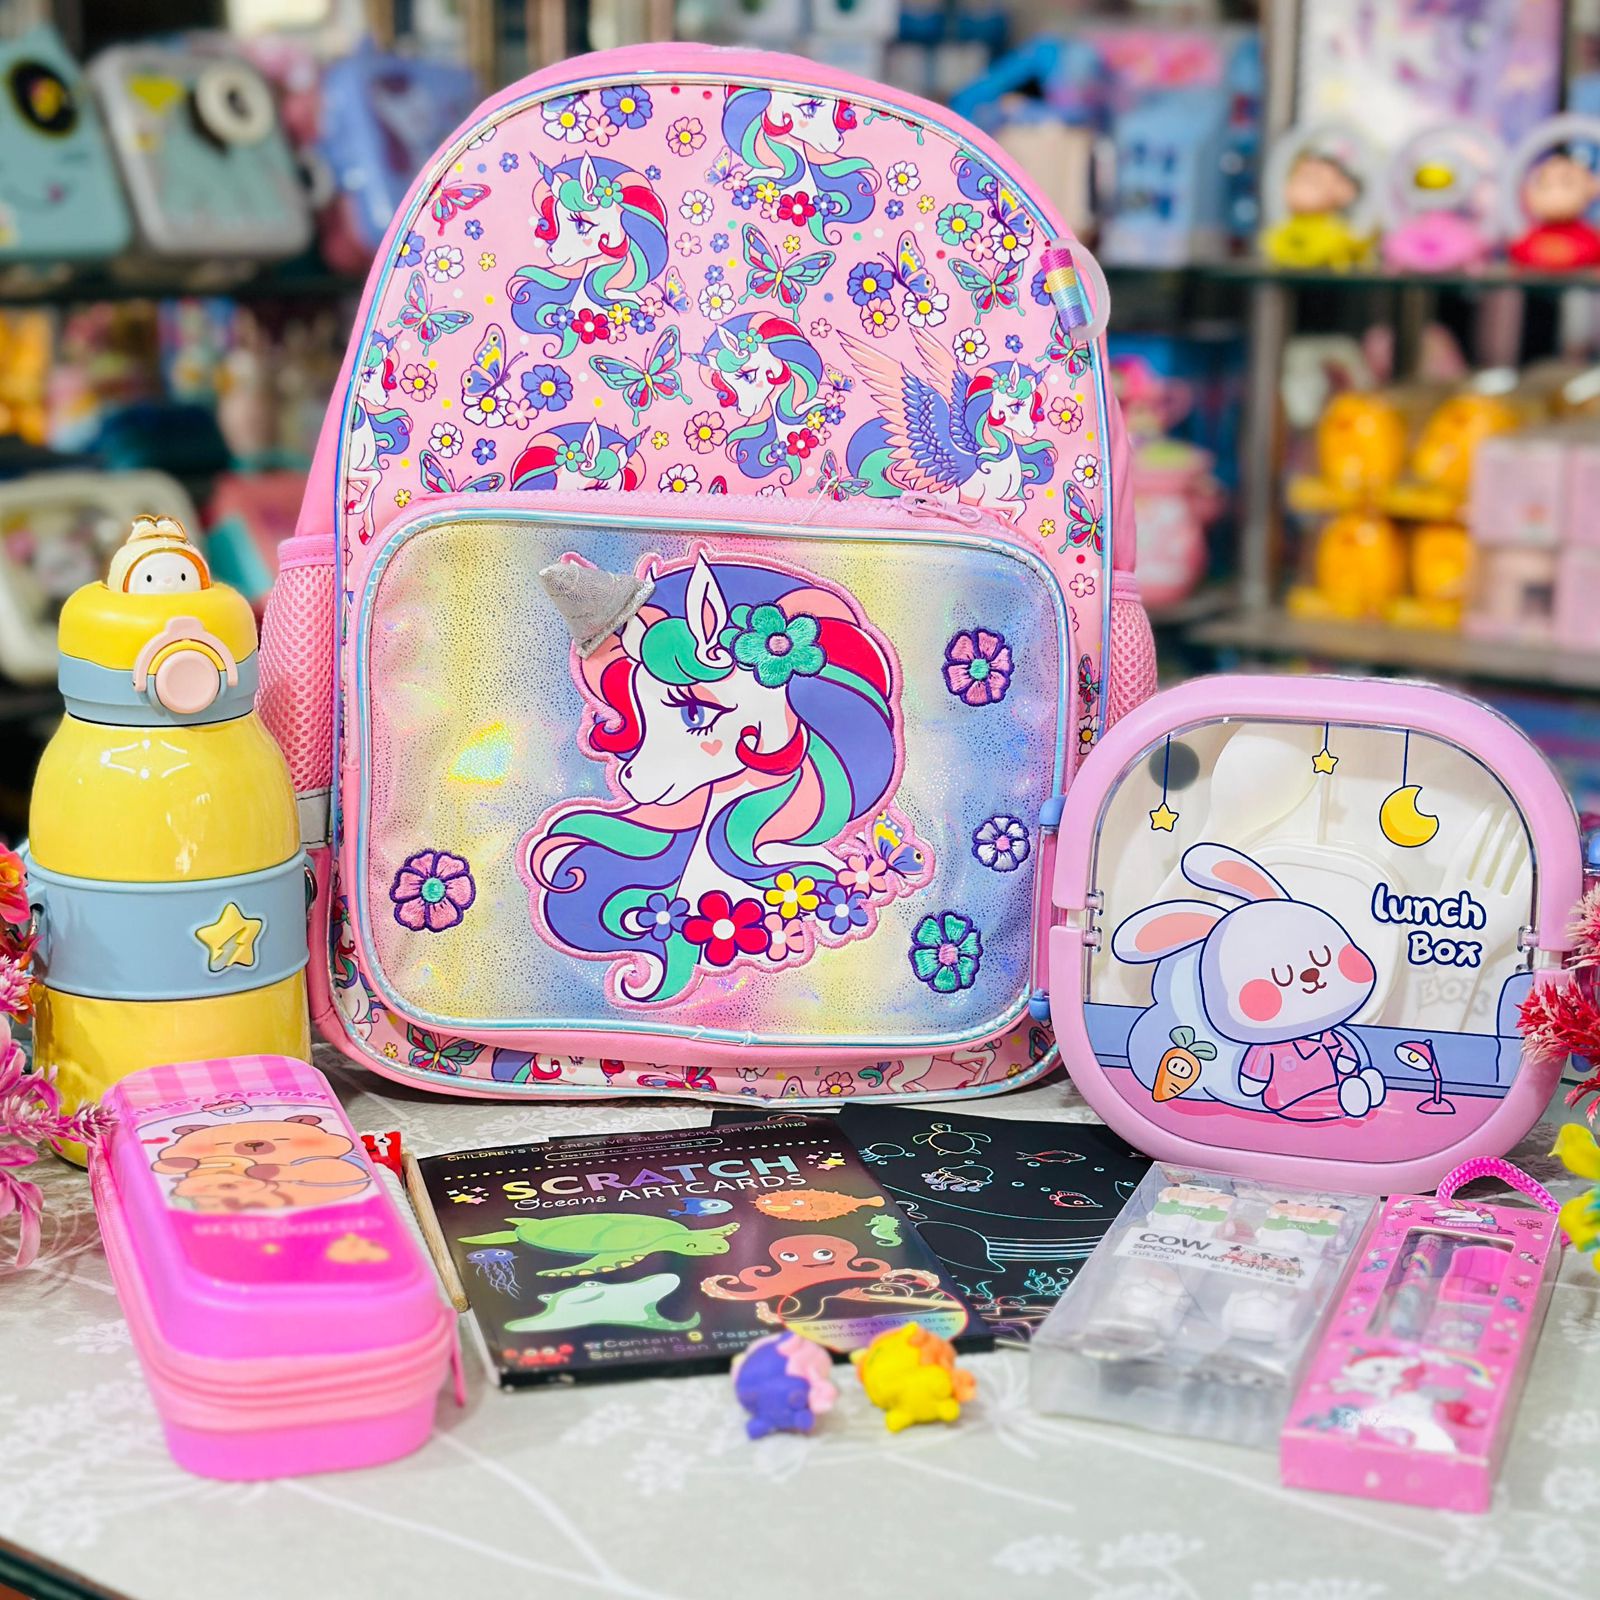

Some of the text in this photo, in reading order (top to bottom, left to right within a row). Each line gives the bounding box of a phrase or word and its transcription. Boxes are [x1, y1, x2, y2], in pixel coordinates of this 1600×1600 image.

[1408, 930, 1483, 968] Box
[447, 1121, 808, 1162] CHILDREN'S DIY CREATIVE COLOR SCRATCH PAINTING
[502, 1155, 799, 1200] SCRATCH
[513, 1173, 807, 1211] Oceans ARTCARDS
[1133, 1243, 1187, 1255] SPOON
[1192, 1252, 1225, 1263] AND
[1139, 1233, 1212, 1251] COW
[588, 1346, 665, 1360] Scratch
[603, 1334, 680, 1348] Contain
[712, 1329, 771, 1340] Pages
